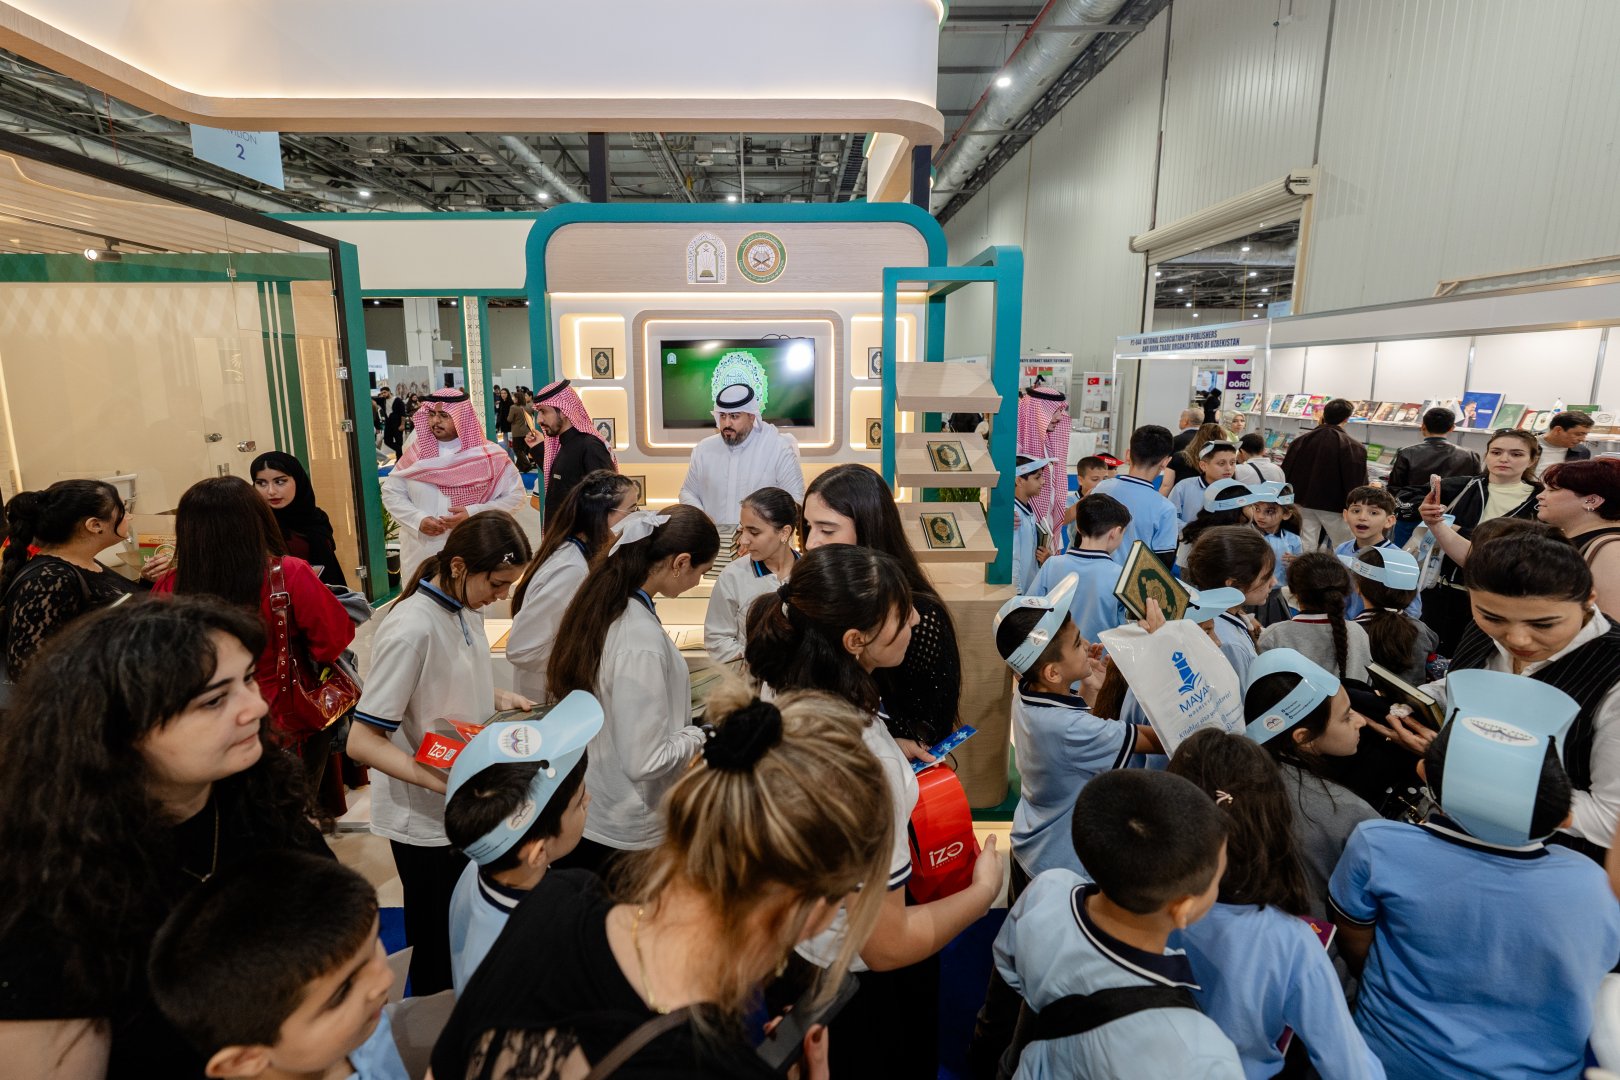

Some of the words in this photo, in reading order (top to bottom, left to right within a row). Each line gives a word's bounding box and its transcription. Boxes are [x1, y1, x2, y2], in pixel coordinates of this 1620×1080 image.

[236, 142, 246, 160] 2
[1143, 336, 1159, 345] NATIONAL
[1160, 334, 1184, 344] ASSOCIATION
[1191, 330, 1218, 340] PUBLISHERS
[1160, 343, 1172, 351] TRADE
[1172, 341, 1204, 350] ORGANIZATIONS
[1204, 340, 1210, 348] OF
[1210, 338, 1240, 348] UZBEKISTAN
